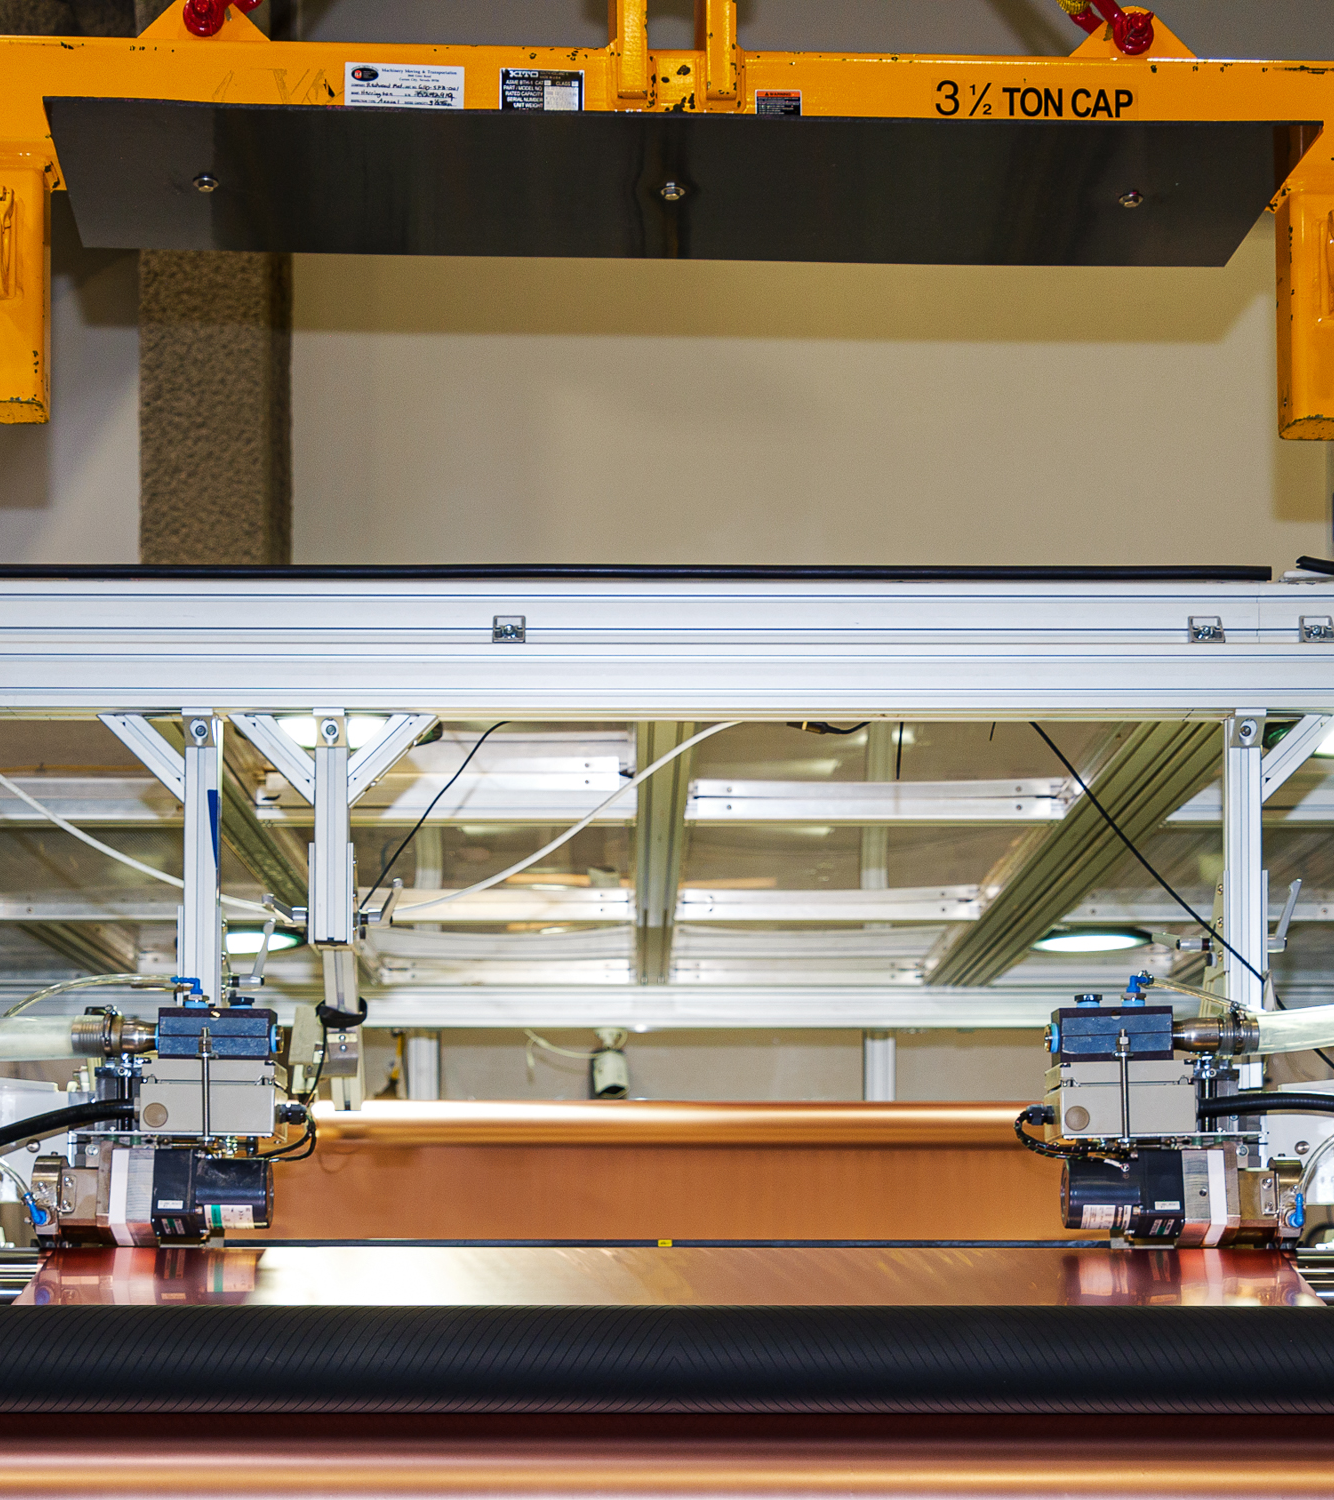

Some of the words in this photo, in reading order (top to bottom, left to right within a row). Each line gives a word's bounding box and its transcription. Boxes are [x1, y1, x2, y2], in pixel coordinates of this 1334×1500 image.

[935, 80, 960, 116] 3
[1002, 87, 1063, 117] TON
[1071, 88, 1134, 118] CAP
